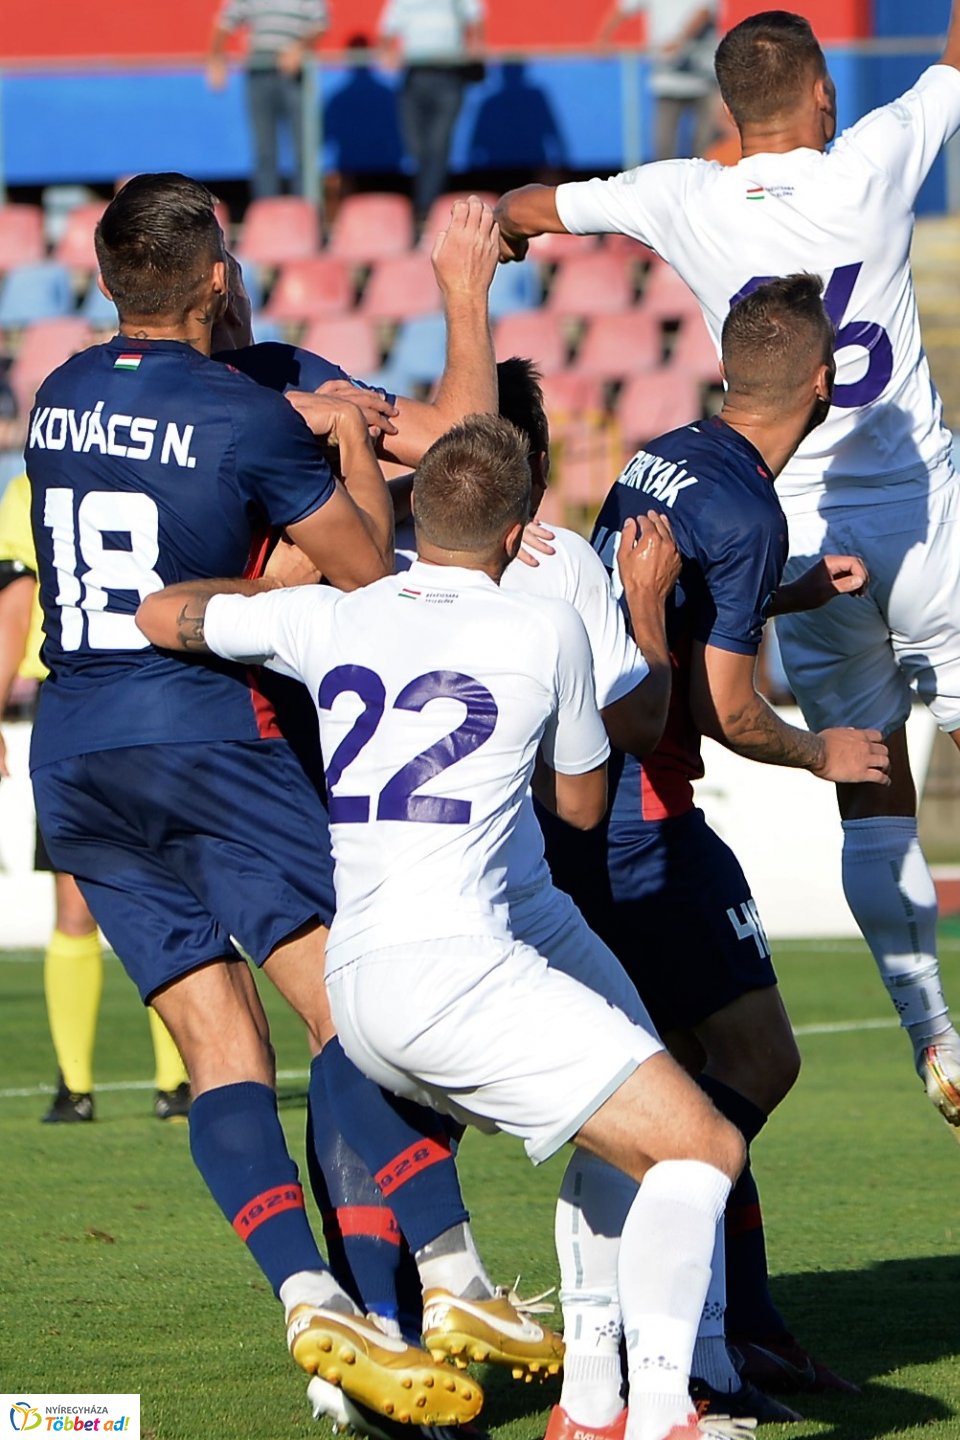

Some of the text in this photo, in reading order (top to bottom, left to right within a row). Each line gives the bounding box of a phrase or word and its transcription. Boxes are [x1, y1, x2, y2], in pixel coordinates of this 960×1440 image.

[29, 401, 197, 469] KOVÁCS N.
[43, 487, 166, 652] 18
[318, 664, 499, 824] 22
[380, 1147, 430, 1192] 928
[241, 1190, 297, 1227] 1928
